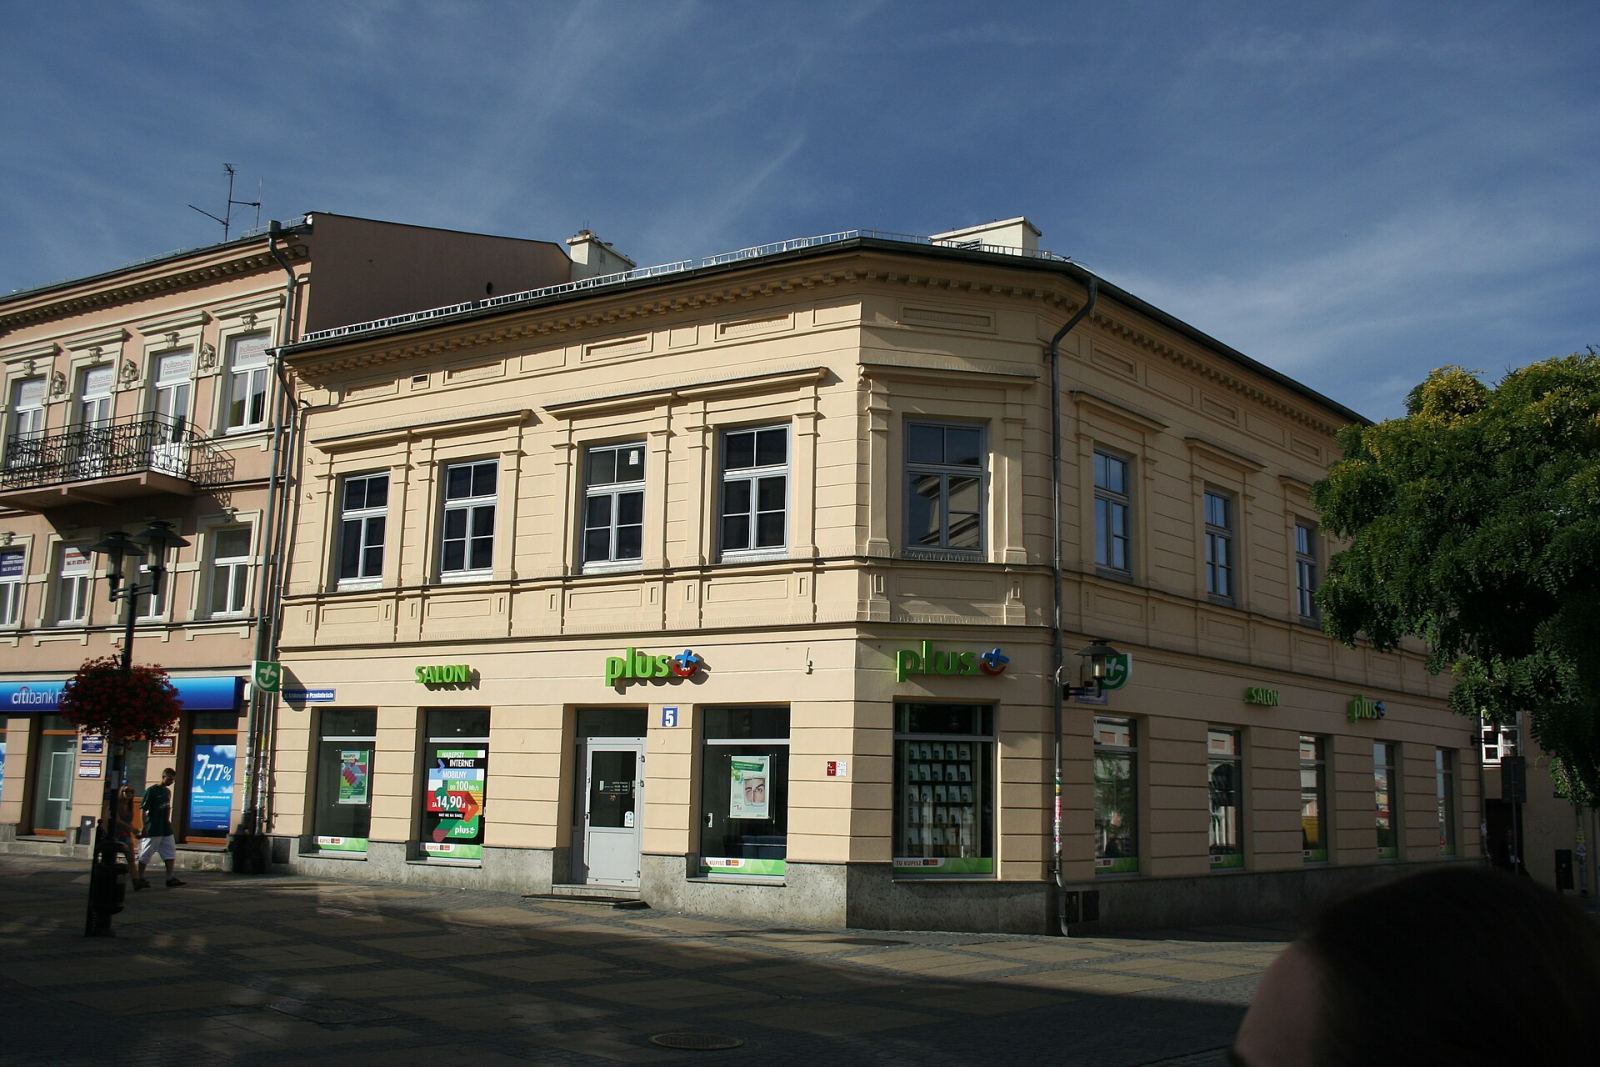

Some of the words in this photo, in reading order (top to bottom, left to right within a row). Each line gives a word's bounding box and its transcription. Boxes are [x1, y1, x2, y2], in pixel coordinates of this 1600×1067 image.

[604, 647, 672, 687] plus
[896, 640, 977, 683] plus
[415, 665, 470, 684] SALON
[12, 687, 54, 704] citibank
[1250, 687, 1280, 706] SALON
[1350, 695, 1377, 722] plus
[665, 710, 674, 727] 5
[196, 753, 232, 785] 7,77%
[449, 759, 475, 768] INTERNET
[442, 770, 467, 779] MOBILNY
[456, 780, 469, 791] 100
[436, 795, 462, 811] 14,90
[454, 825, 468, 836] plus
